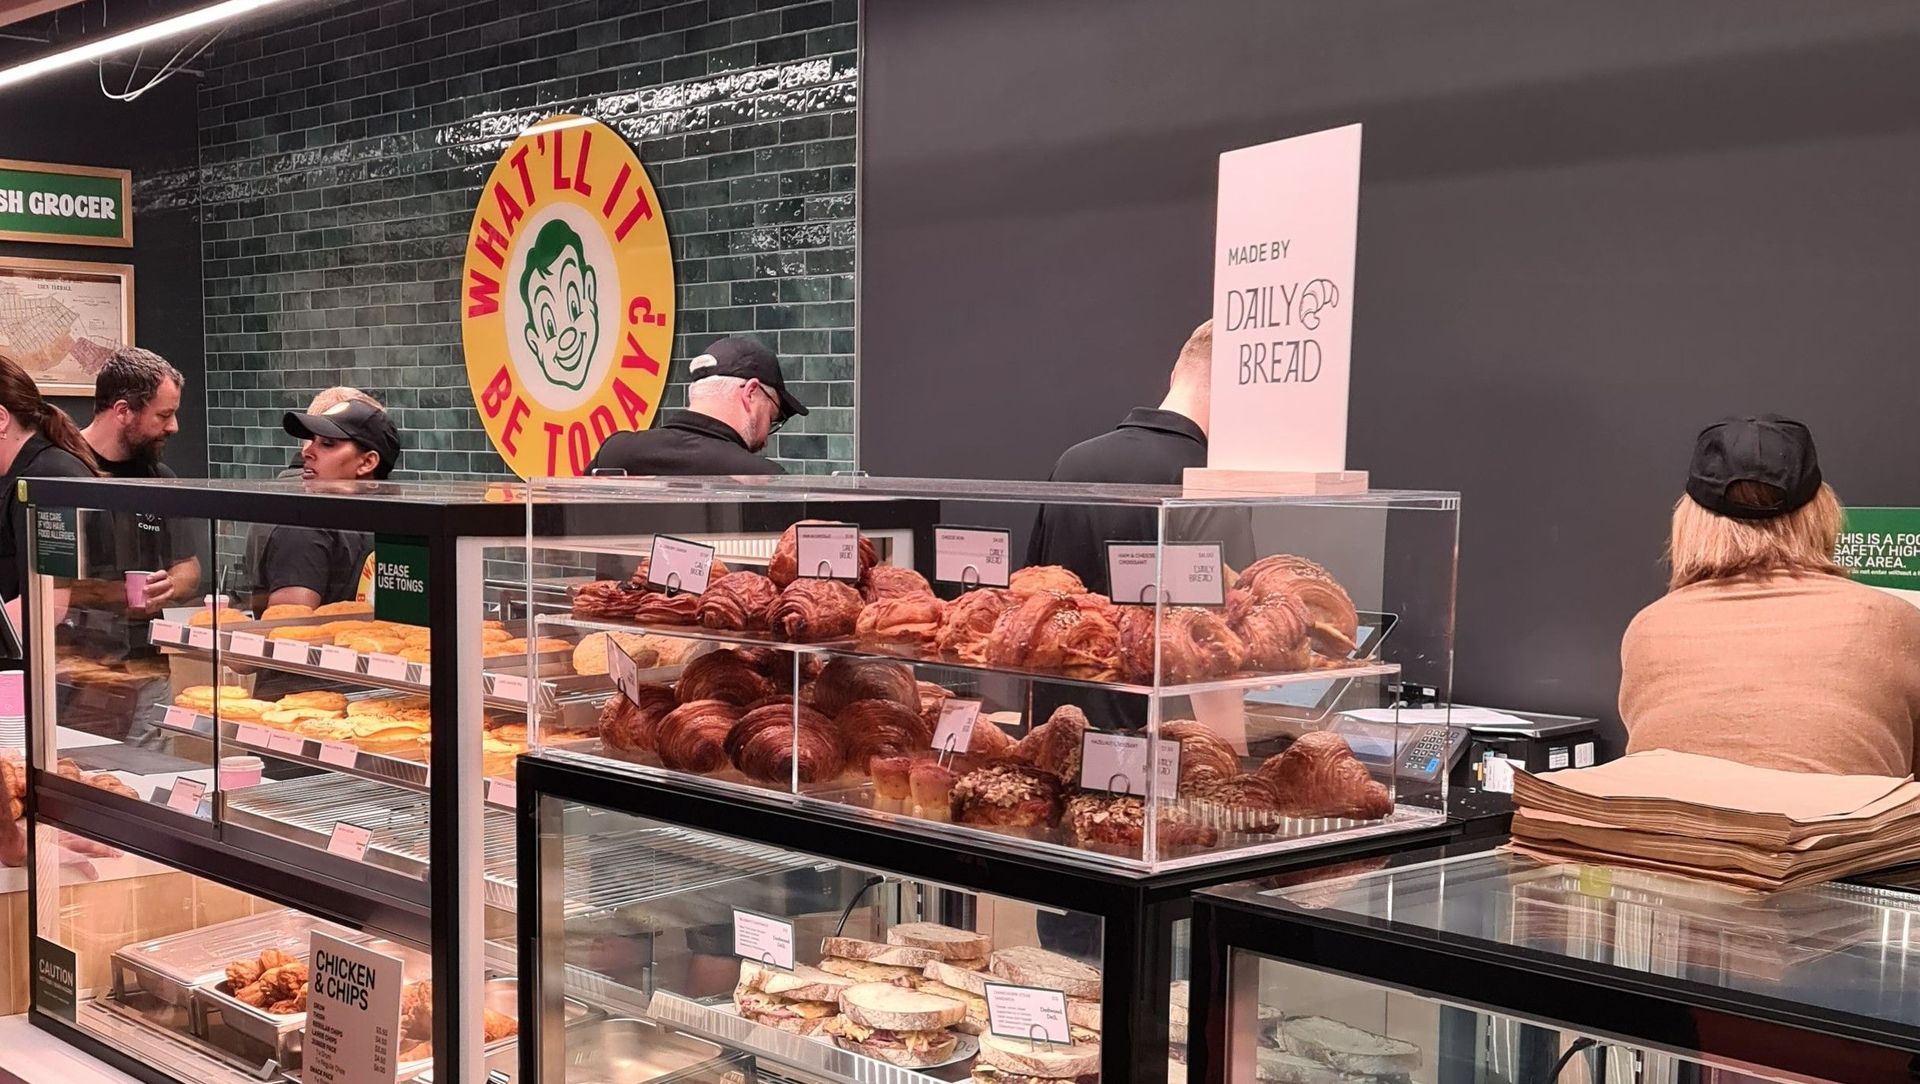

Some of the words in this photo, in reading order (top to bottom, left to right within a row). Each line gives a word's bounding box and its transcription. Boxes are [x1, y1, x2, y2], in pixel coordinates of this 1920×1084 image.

[28, 191, 116, 220] GROCER
[468, 128, 592, 318] WHAT'LL
[602, 162, 653, 242] IT
[1228, 243, 1267, 266] MADE
[1271, 239, 1290, 260] BY
[1226, 283, 1298, 331] DAILY
[1239, 339, 1322, 385] BREAD
[481, 364, 531, 457] BE
[1834, 544, 1885, 555] SAFETY
[1868, 533, 1880, 544] IS
[1883, 533, 1893, 545] A
[378, 562, 409, 578] PLEASE
[1833, 555, 1862, 567] RISK
[1865, 556, 1906, 568] AREA.
[378, 575, 394, 589] USE
[396, 577, 424, 593] TONGS
[39, 959, 73, 987] CAUTION
[316, 950, 376, 990] CHICKEN
[314, 972, 324, 994] &
[327, 977, 368, 1011] CHIPS
